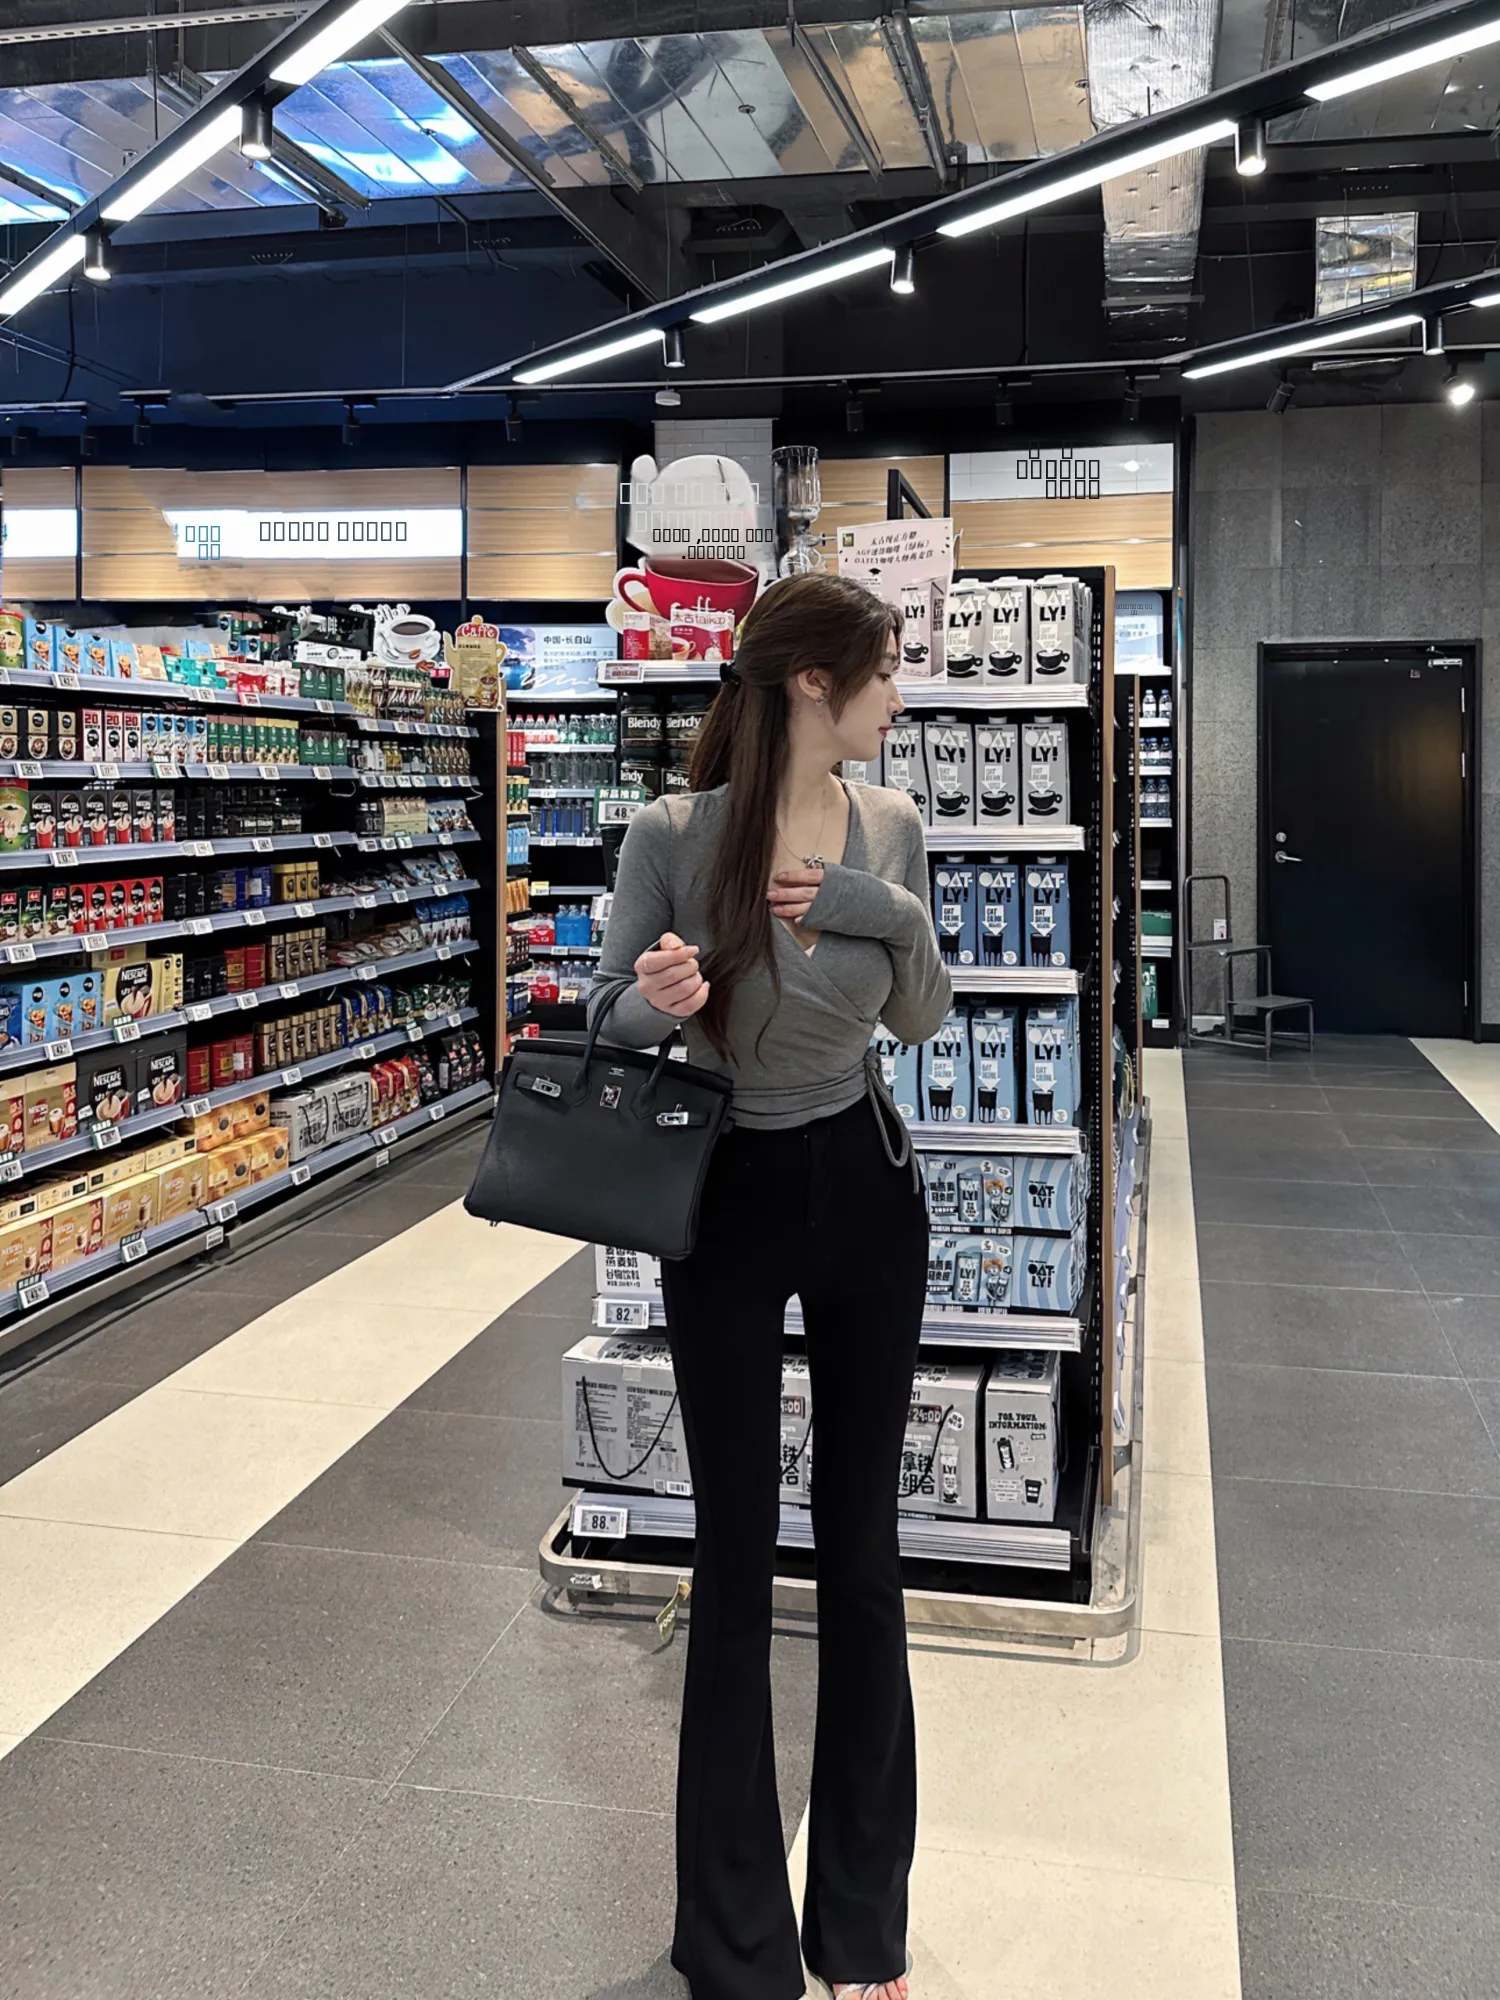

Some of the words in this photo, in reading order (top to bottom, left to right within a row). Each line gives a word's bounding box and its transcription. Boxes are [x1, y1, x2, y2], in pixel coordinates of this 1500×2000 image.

[905, 605, 926, 619] LY!
[950, 611, 982, 628] LY!
[993, 607, 1019, 623] LY!
[1040, 605, 1066, 621] LY!
[85, 713, 98, 724] 20
[107, 715, 119, 725] 20
[126, 716, 138, 726] 20
[627, 717, 661, 729] Blendy
[892, 744, 915, 758] LY!
[934, 744, 966, 763] LY!
[985, 747, 1011, 763] LY!
[1031, 746, 1058, 762] LY!
[621, 769, 644, 784] lendy
[943, 887, 968, 904] LY!
[986, 887, 1011, 904] LY!
[1034, 888, 1060, 904] LY!
[933, 1041, 961, 1057] LY!
[981, 1042, 1006, 1058] LY!
[1035, 1044, 1061, 1060] LY!
[1032, 1196, 1052, 1209] LY!
[1032, 1275, 1052, 1288] LY!
[998, 1412, 1014, 1421] FOR
[1016, 1413, 1037, 1421] YOUR
